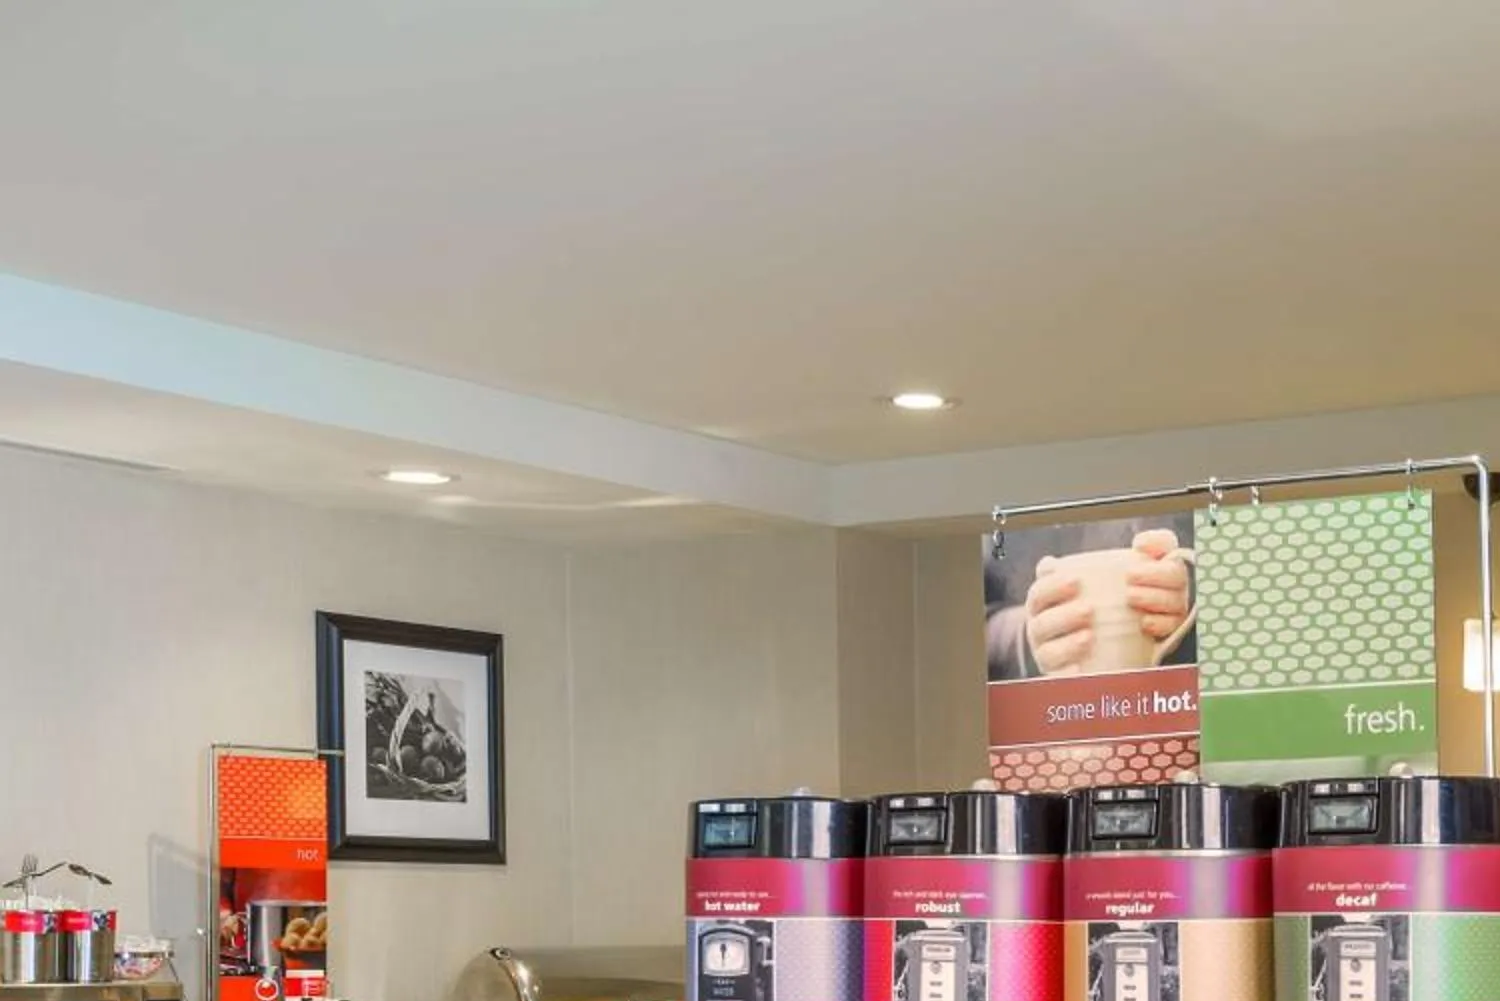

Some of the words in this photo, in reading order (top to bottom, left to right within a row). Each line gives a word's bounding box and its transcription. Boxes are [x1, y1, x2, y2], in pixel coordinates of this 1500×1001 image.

[1047, 702, 1095, 723] some
[1101, 694, 1131, 718] like
[1137, 692, 1149, 716] it
[1153, 689, 1197, 713] hot.
[1343, 700, 1425, 735] fresh.
[704, 900, 721, 911] hot
[723, 901, 761, 911] water
[914, 900, 961, 913] robust
[1335, 892, 1378, 907] decaf
[1105, 901, 1155, 917] regular
